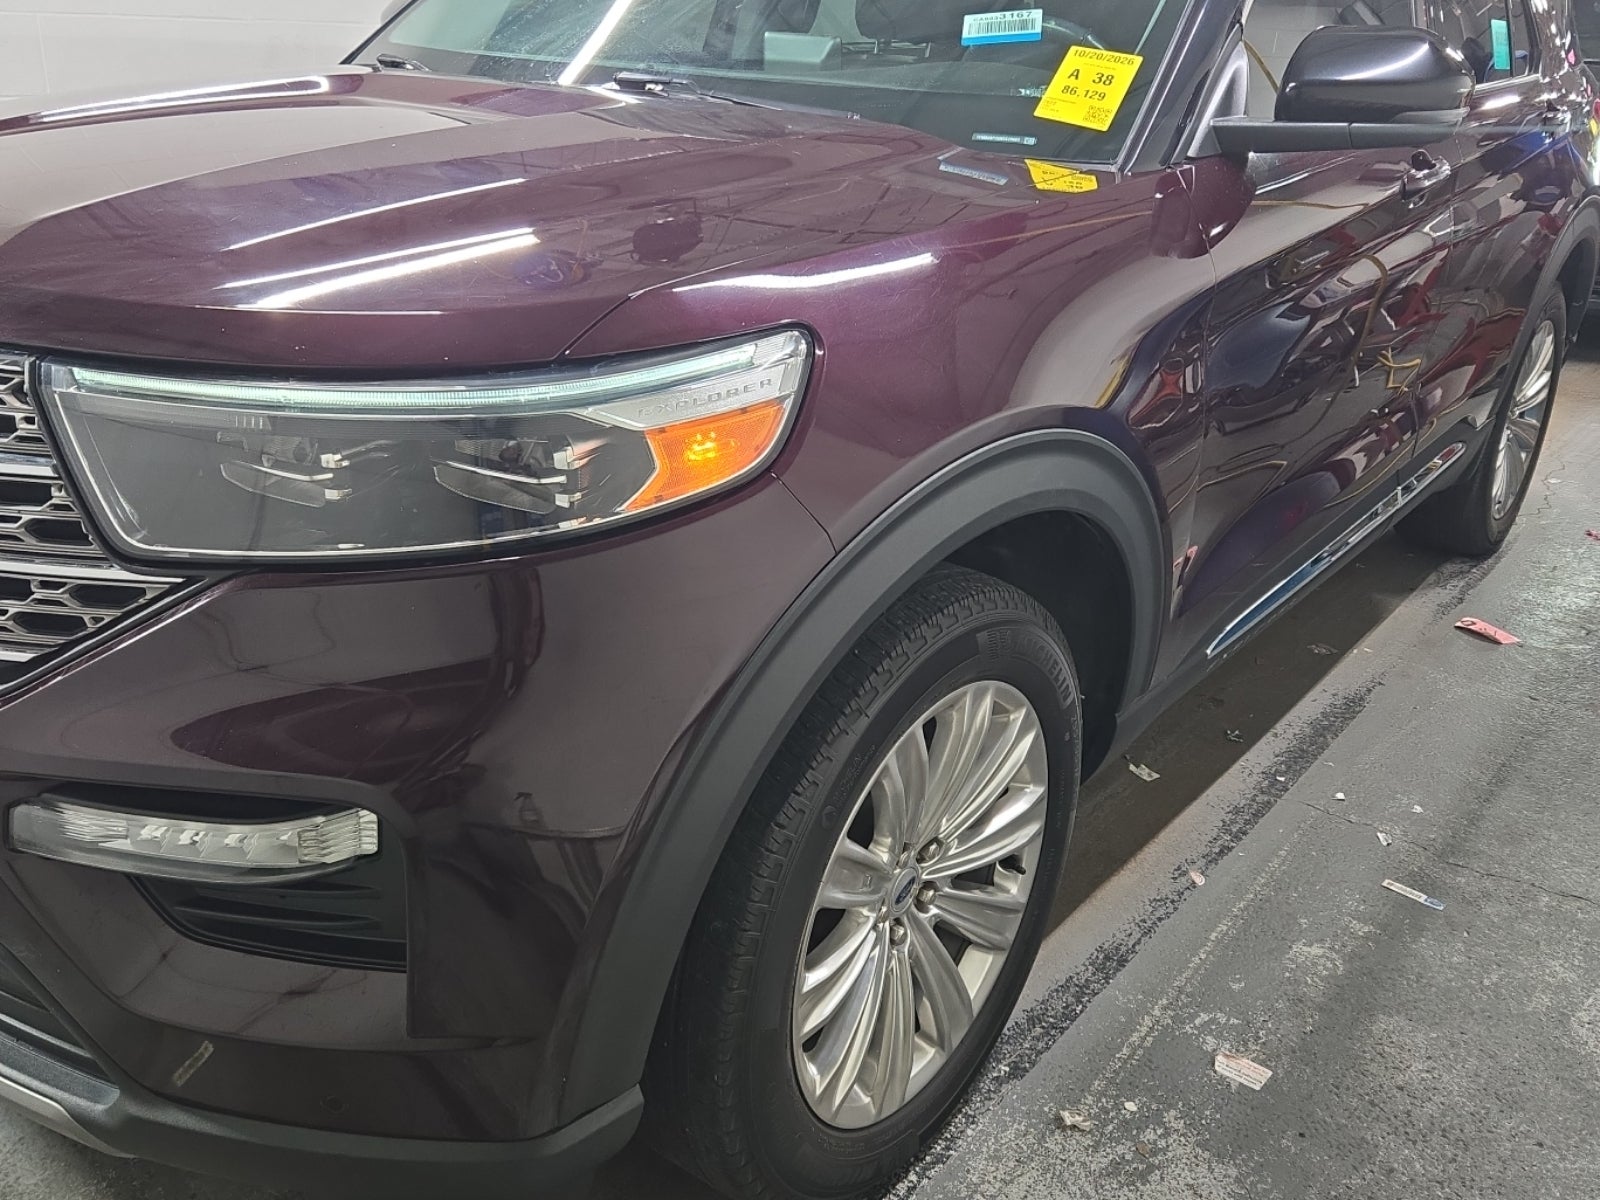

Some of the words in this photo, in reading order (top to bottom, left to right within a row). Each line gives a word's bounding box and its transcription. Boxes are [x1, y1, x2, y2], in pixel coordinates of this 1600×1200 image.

[1073, 48, 1136, 66] 10/20/2026
[1067, 68, 1081, 81] A
[1092, 72, 1115, 87] 38
[638, 378, 772, 416] EXPLORER
